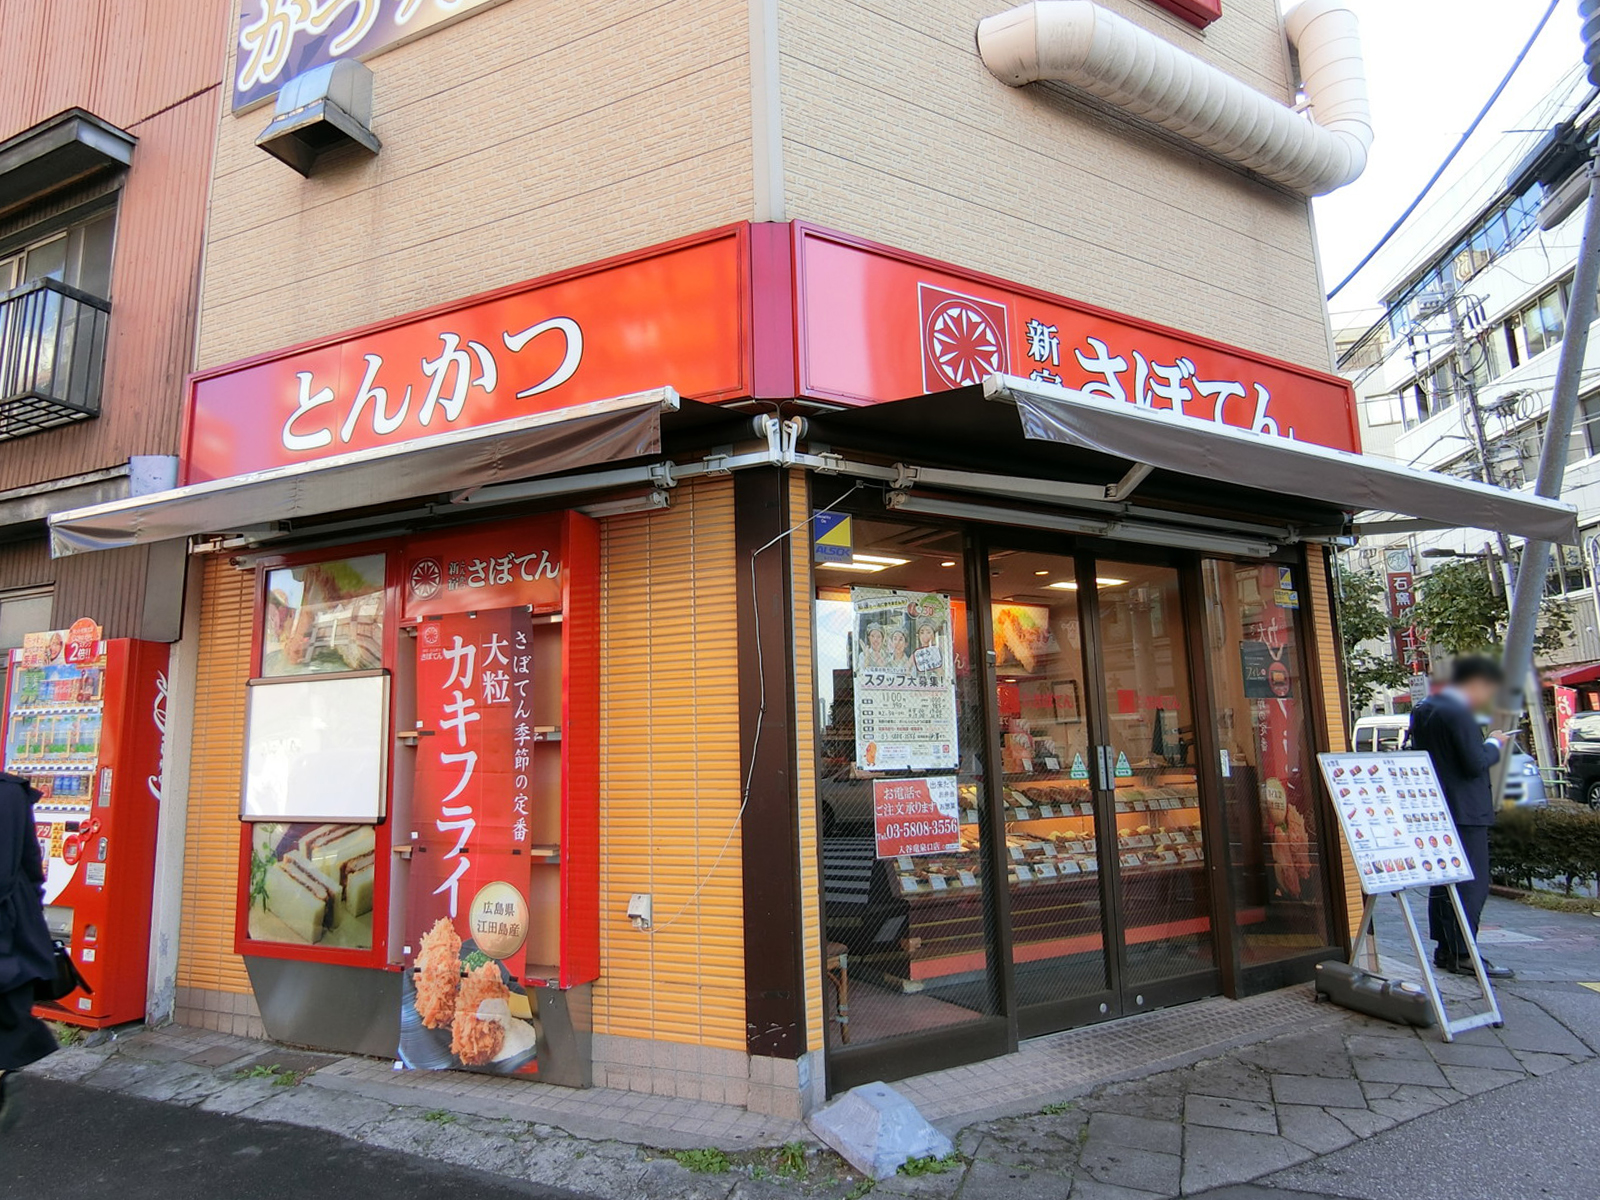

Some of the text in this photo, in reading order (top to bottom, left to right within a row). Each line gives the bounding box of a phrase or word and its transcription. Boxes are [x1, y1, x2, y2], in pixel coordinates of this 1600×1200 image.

[281, 316, 583, 451] とんかつ
[1074, 337, 1296, 442] さぼてん
[815, 545, 850, 558] ALSOK
[467, 550, 560, 588] さぼてん
[482, 632, 511, 705] 大粒
[511, 629, 533, 842] さぼてん季節の定番
[431, 634, 481, 919] カキフライ
[883, 785, 922, 800] お電話で
[876, 801, 937, 816] ご注文承ります
[886, 819, 958, 840] 03-5808-3556
[483, 901, 516, 917] 広島県
[476, 919, 521, 938] 江田島産
